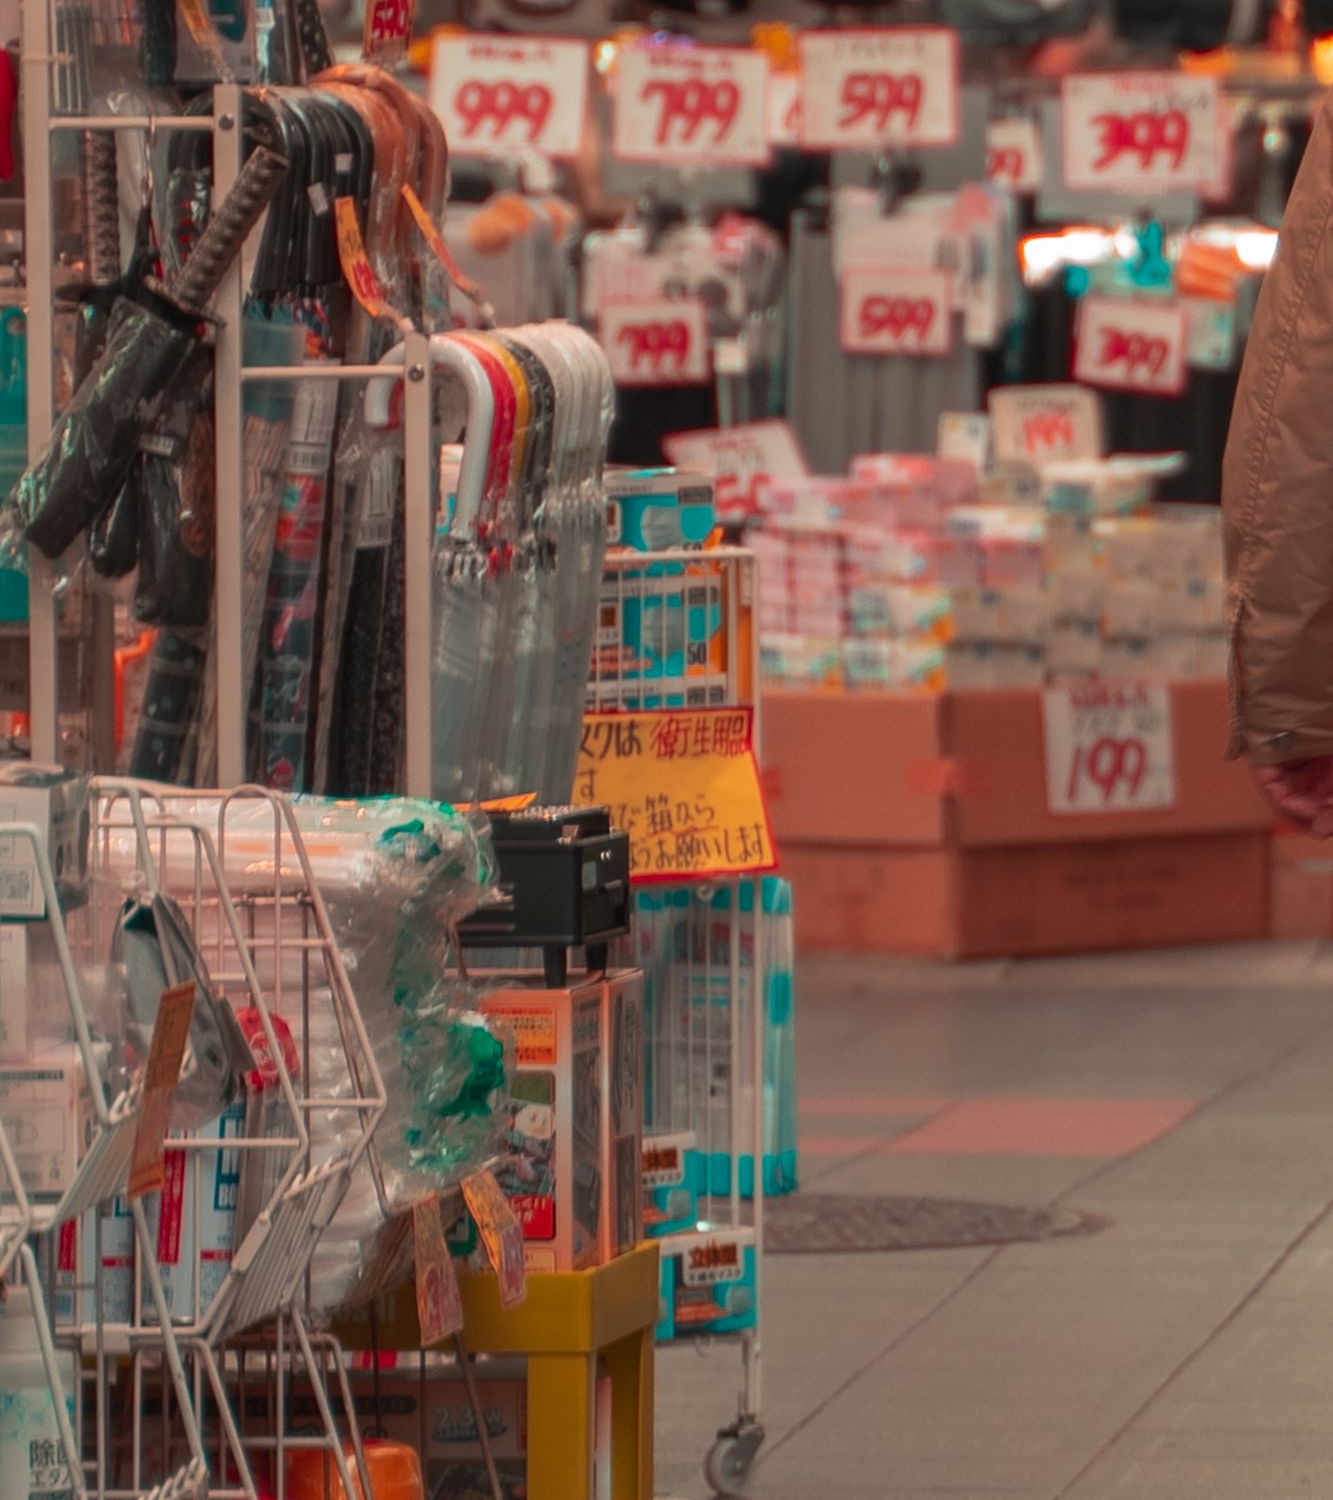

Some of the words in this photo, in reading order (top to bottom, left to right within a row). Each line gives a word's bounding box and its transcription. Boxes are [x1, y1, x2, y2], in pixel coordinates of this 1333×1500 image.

[454, 80, 552, 142] 999
[640, 78, 742, 147] 799
[837, 72, 923, 134] 599
[1089, 110, 1190, 172] 399
[616, 320, 692, 372] 799
[857, 293, 936, 343] 599
[1063, 736, 1149, 802] 199
